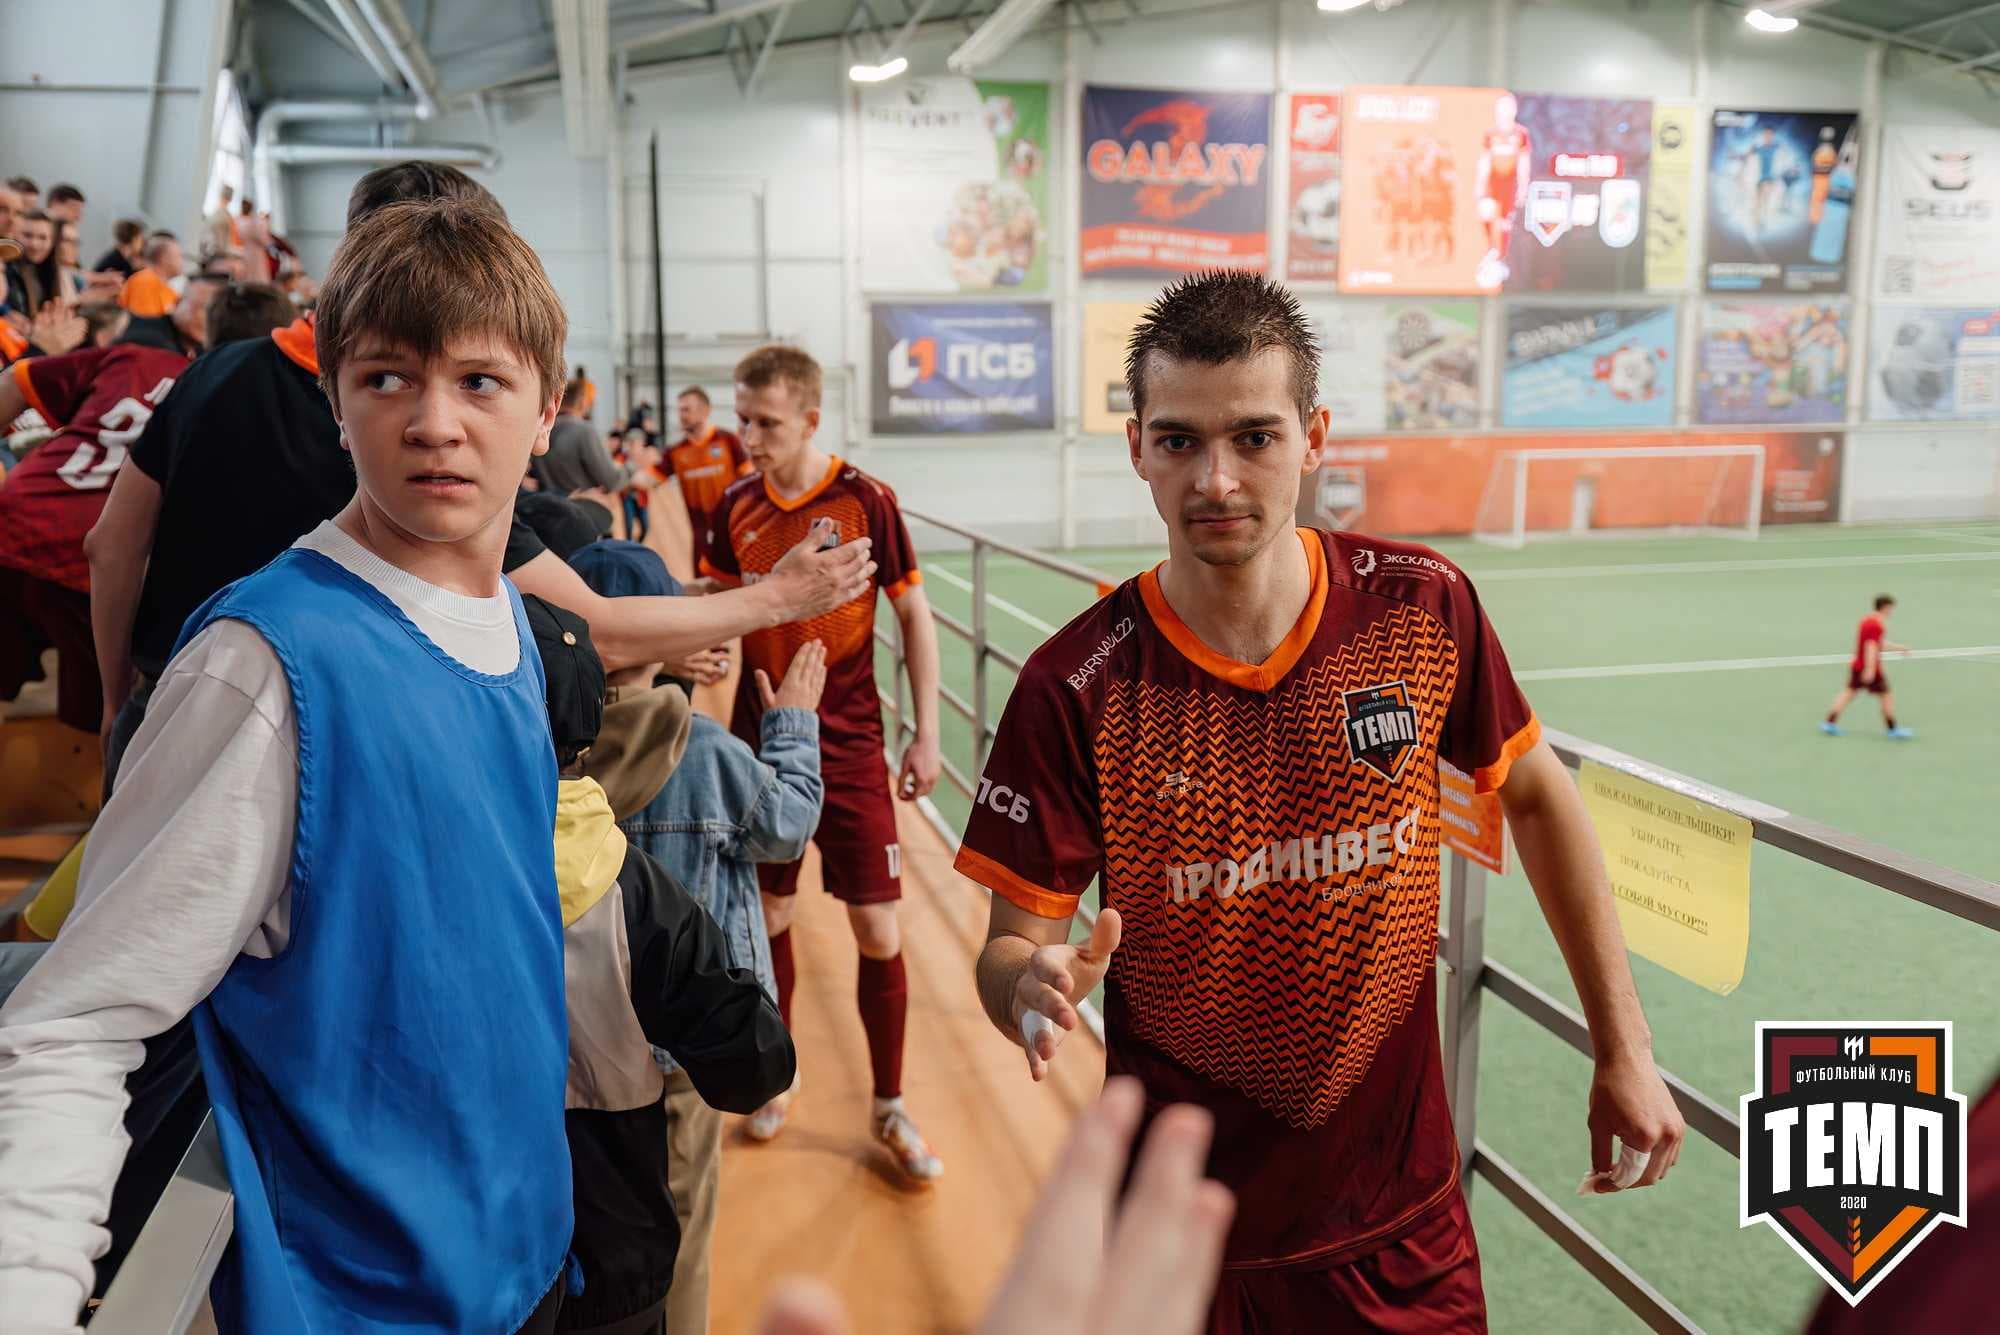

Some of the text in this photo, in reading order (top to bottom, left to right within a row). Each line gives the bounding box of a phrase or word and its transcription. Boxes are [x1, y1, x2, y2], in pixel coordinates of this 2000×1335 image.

[1087, 139, 1267, 186] GALAXY
[945, 341, 1036, 381] ПСБ
[1381, 554, 1457, 582] ЭКСКЛЮЗИВ
[1351, 711, 1414, 751] ТЕМП
